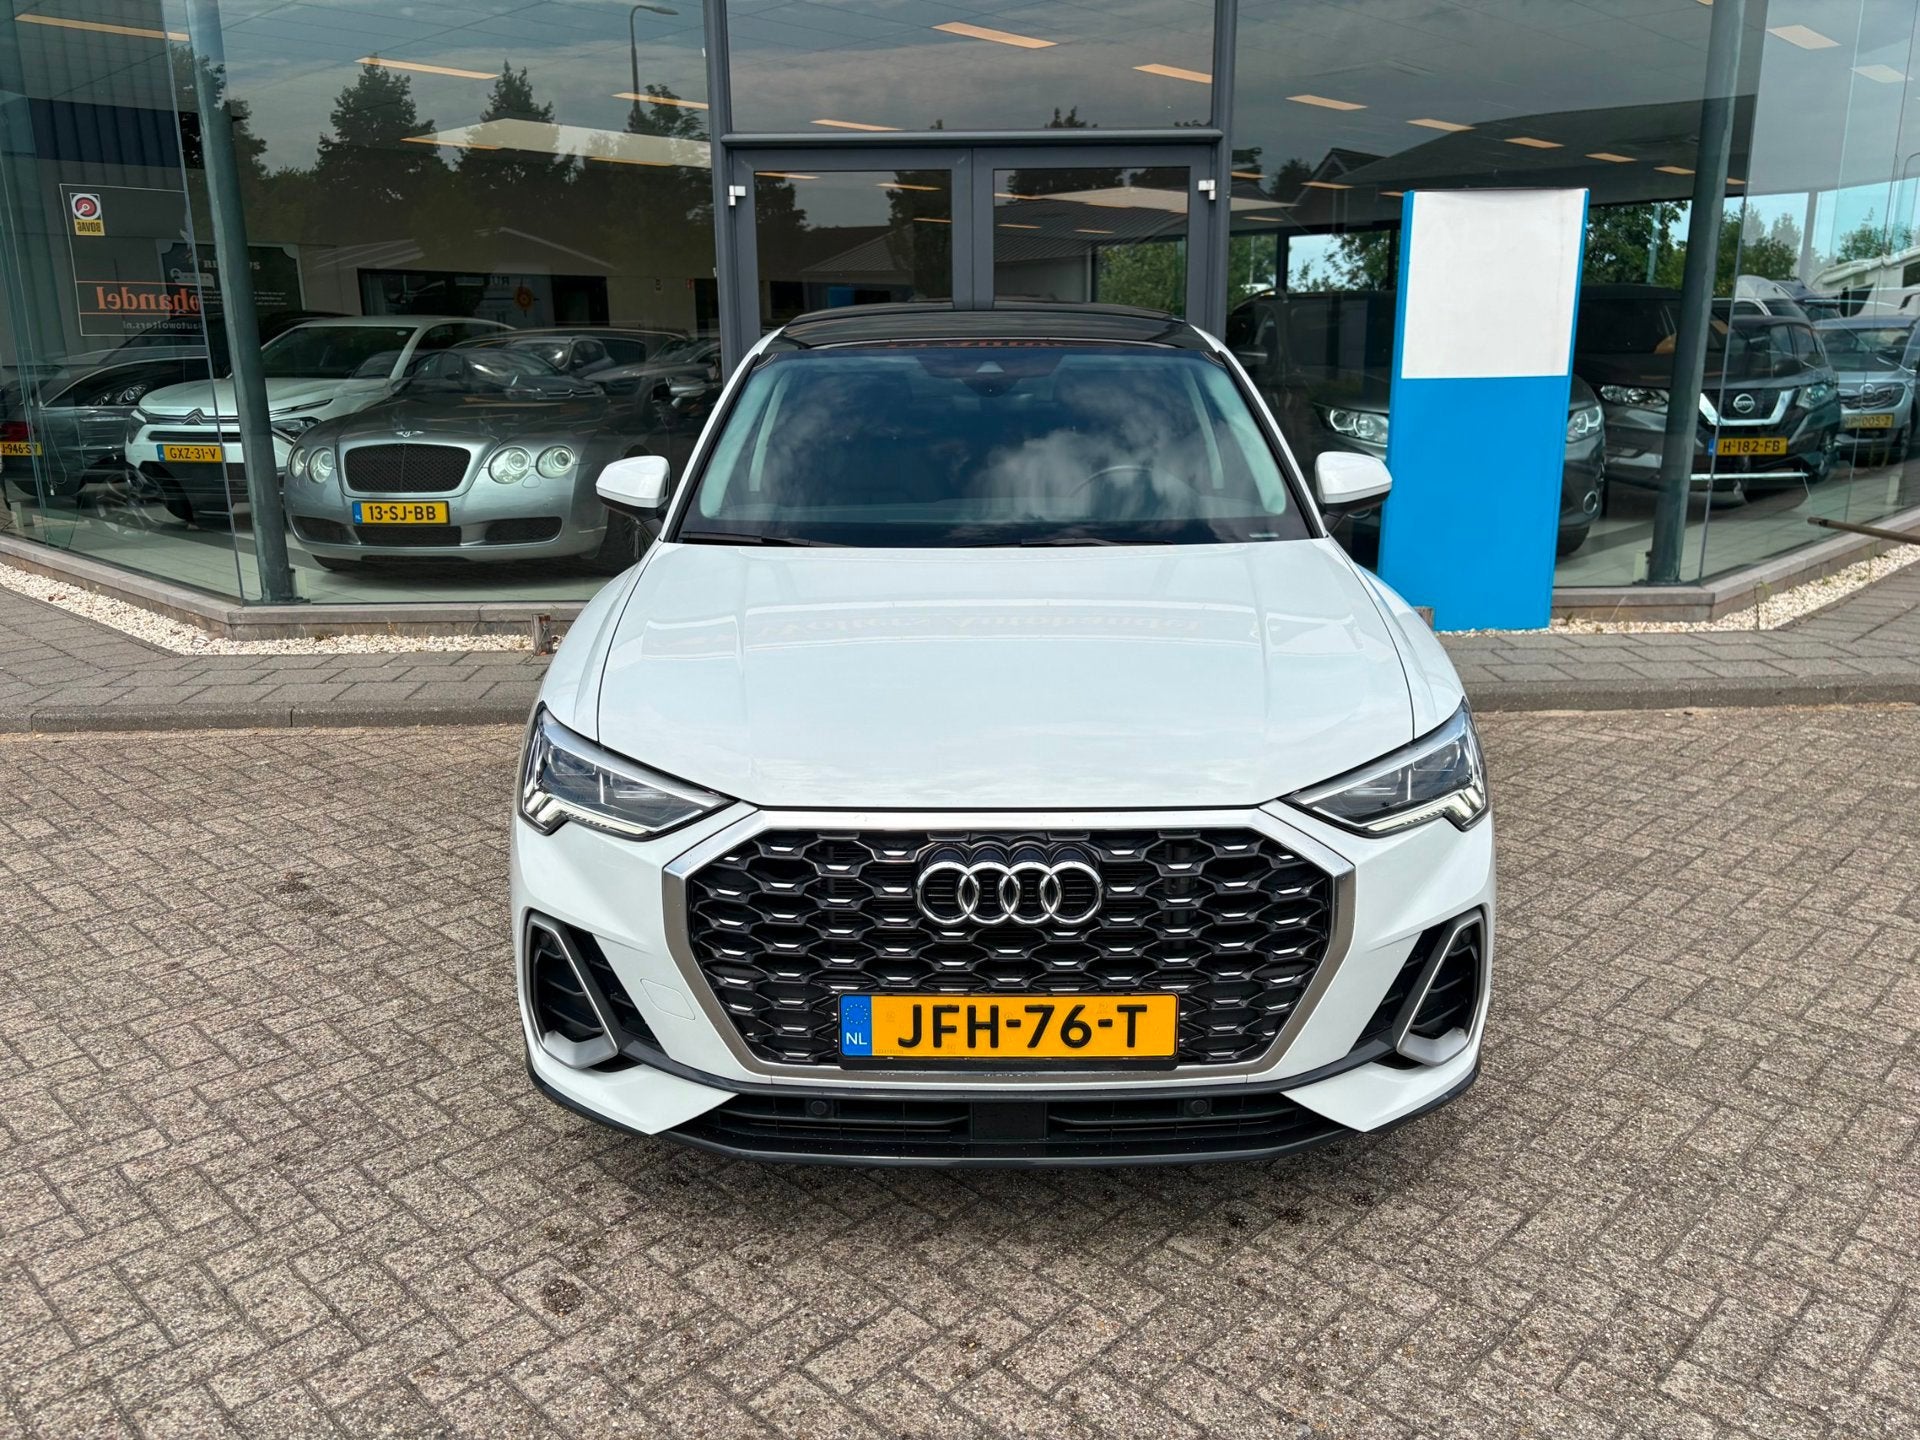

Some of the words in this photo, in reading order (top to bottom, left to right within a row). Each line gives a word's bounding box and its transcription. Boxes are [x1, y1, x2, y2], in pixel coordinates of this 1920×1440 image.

[170, 447, 216, 459] GXZ-31-V
[1723, 440, 1780, 453] H-182-FB
[368, 505, 436, 520] 13-SJ-BB
[898, 1004, 1147, 1049] JFH-76-T
[846, 1032, 867, 1046] NL
